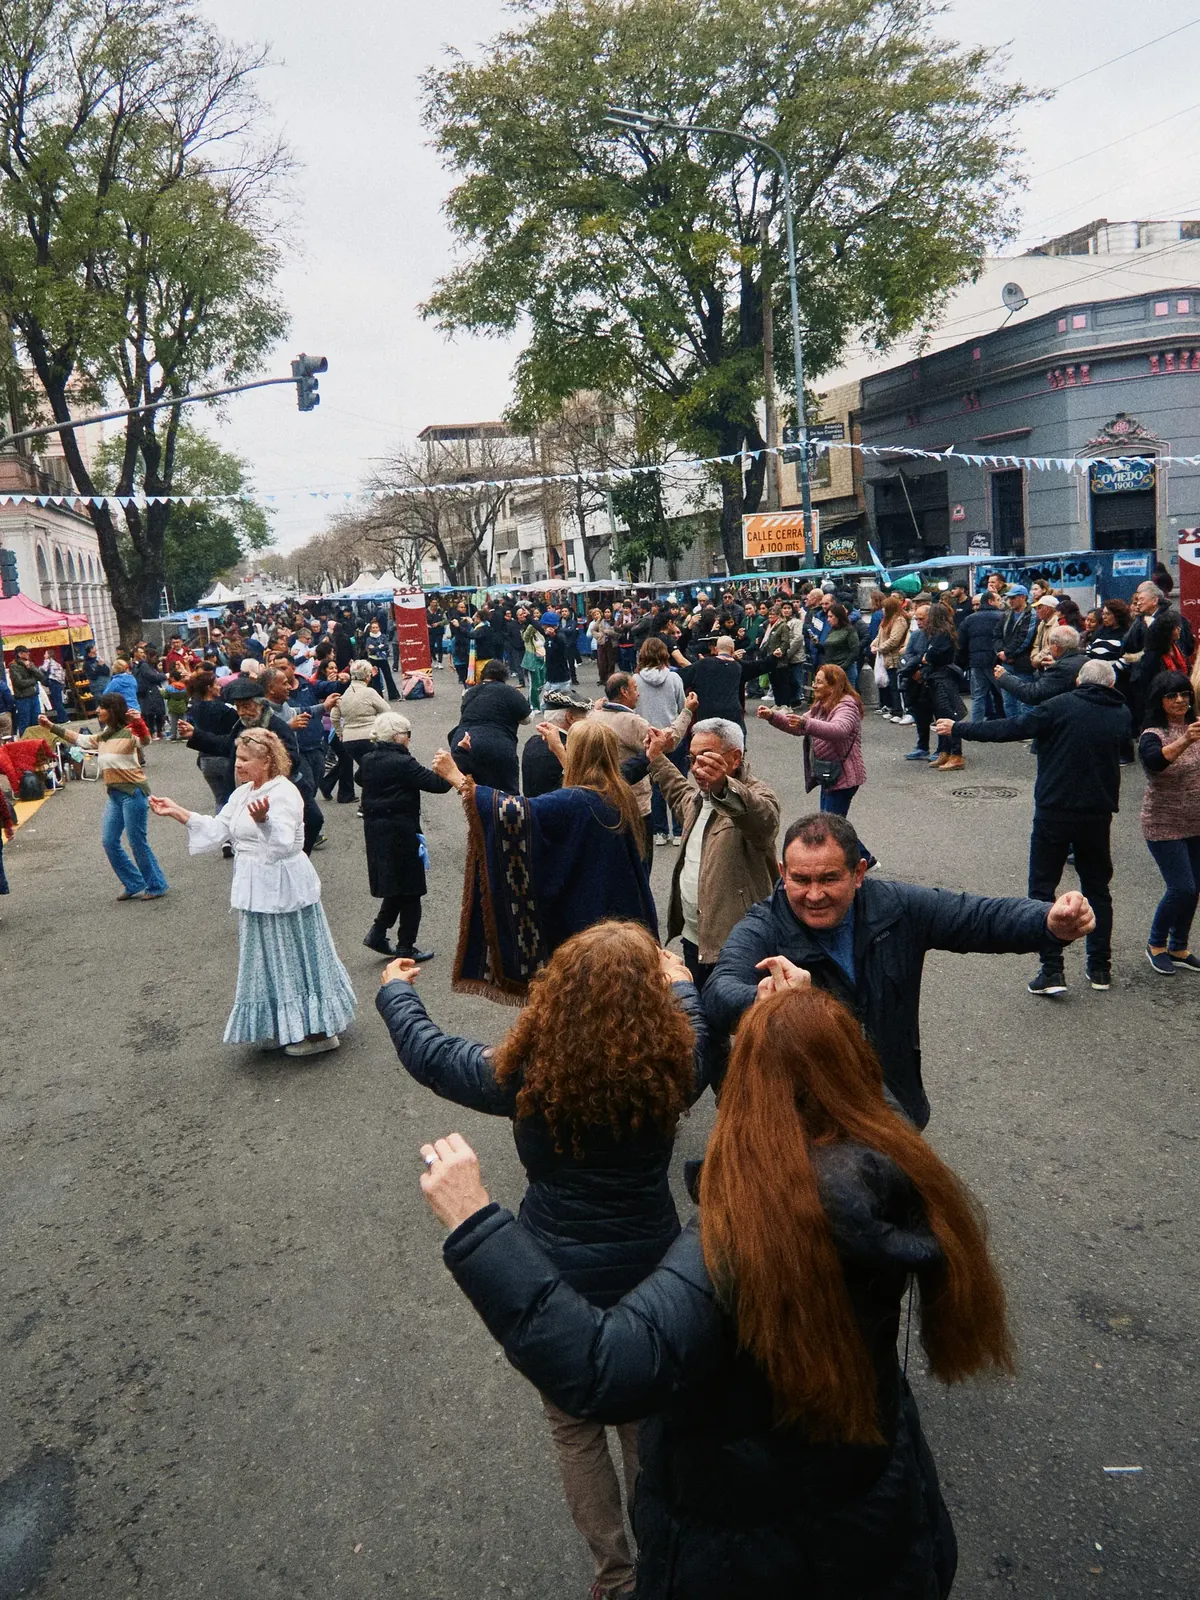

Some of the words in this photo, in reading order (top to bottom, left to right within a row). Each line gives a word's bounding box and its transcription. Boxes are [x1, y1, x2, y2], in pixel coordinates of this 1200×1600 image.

[1101, 470, 1143, 484] OVIEDO
[1114, 481, 1133, 490] 1900
[747, 530, 772, 541] CALLE
[776, 528, 805, 540] CERRA
[760, 543, 766, 553] A
[768, 542, 783, 553] 100
[785, 541, 800, 551] mts
